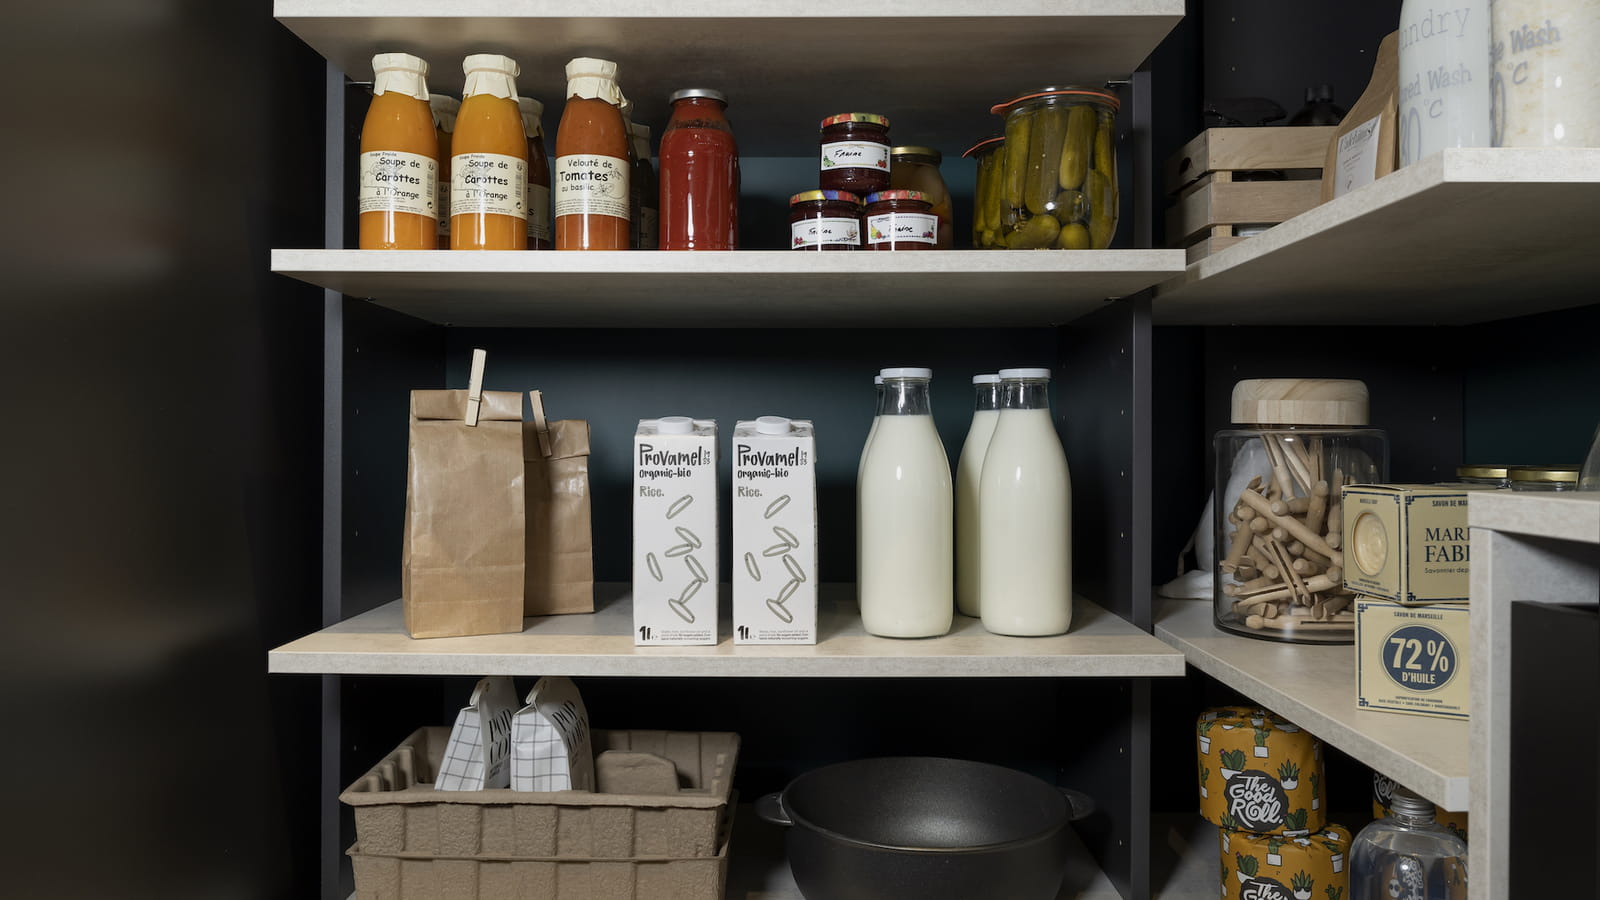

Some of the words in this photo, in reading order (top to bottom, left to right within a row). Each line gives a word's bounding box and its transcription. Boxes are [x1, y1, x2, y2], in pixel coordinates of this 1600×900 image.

[1510, 19, 1560, 54] Wash
[1427, 63, 1472, 91] Wash
[379, 157, 406, 167] Soupe
[409, 160, 420, 168] de
[468, 160, 495, 169] Soupe
[498, 161, 509, 169] de
[568, 158, 599, 167] Velouté
[602, 160, 613, 169] de
[375, 172, 420, 184] Carottes
[465, 174, 508, 185] Carottes
[560, 170, 608, 182] Tomates
[384, 187, 420, 200] l'Orange
[640, 443, 702, 466] Provamel
[737, 444, 800, 466] Provamel
[639, 467, 692, 480] organic-bio
[737, 467, 789, 480] organic-bio
[640, 485, 665, 497] Rice.
[738, 485, 763, 497] Rice.
[1390, 637, 1422, 670] 72
[1402, 672, 1436, 684] D'HUILE
[1236, 776, 1271, 792] The
[1229, 783, 1277, 803] Good
[1249, 883, 1283, 899] The
